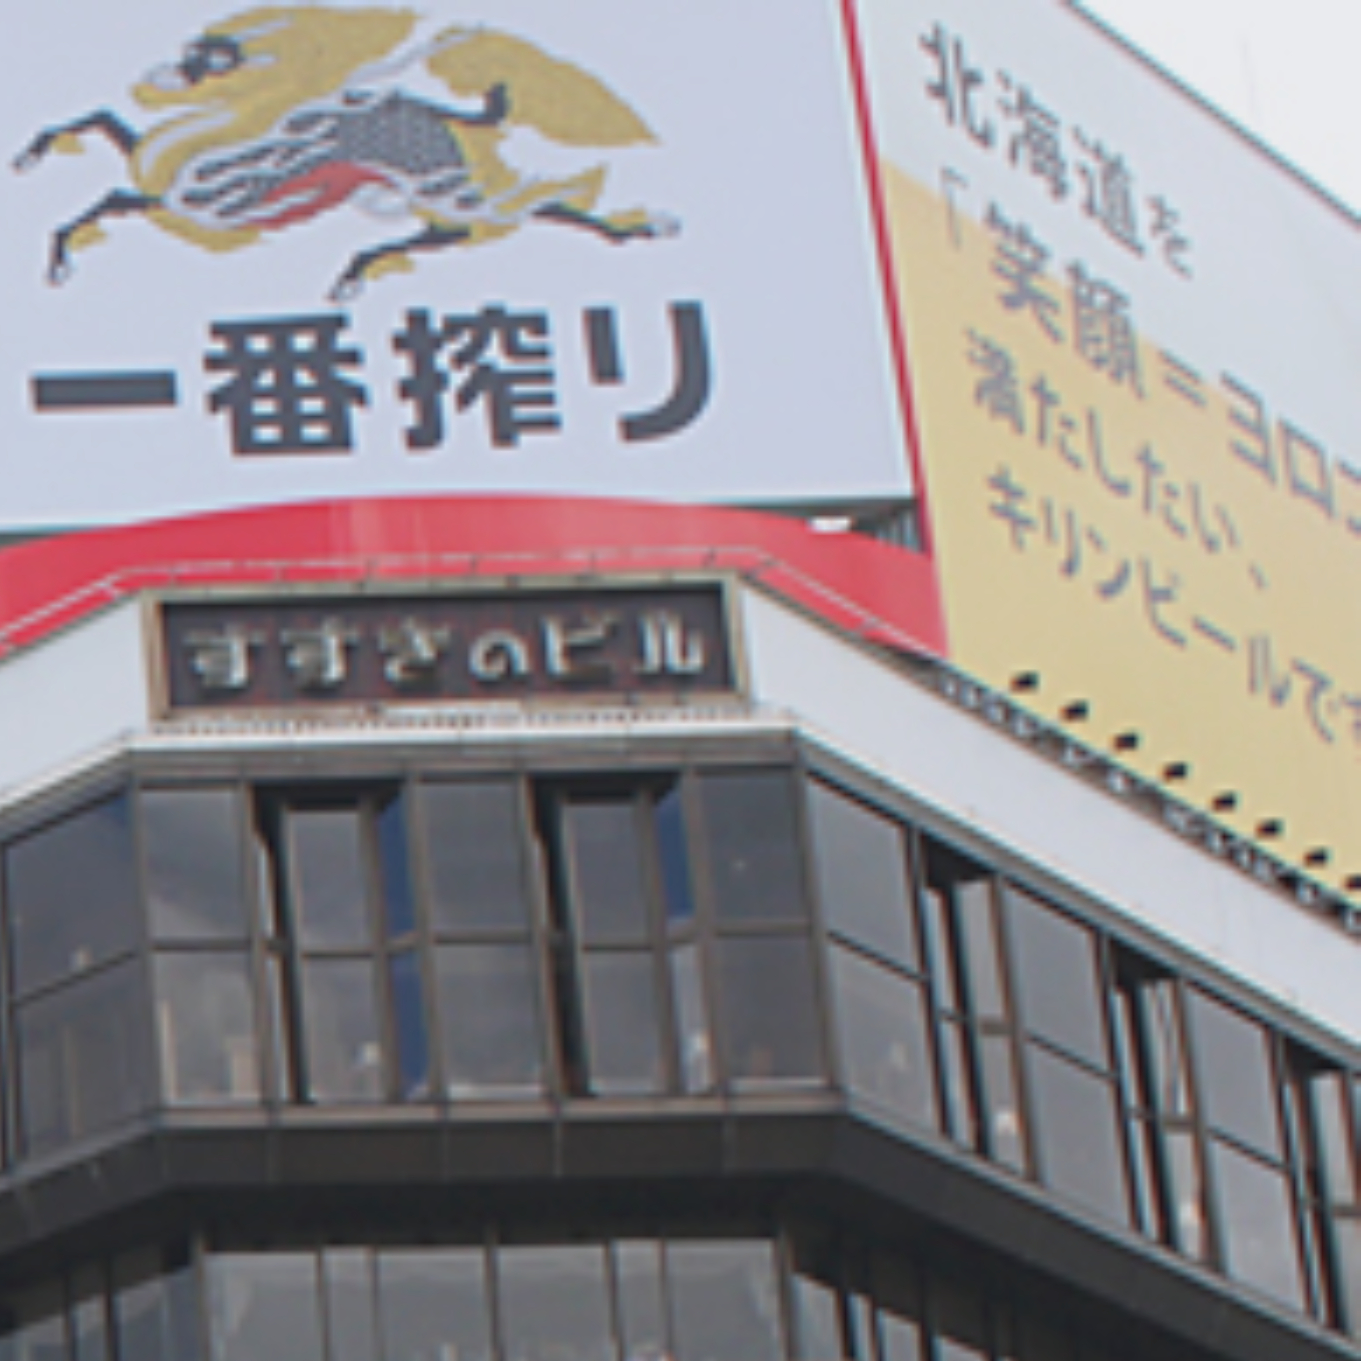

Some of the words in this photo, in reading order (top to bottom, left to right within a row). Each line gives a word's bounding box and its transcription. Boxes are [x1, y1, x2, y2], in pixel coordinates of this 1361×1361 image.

[919, 21, 1193, 279] 北海道を
[30, 300, 712, 457] 一番搾り
[182, 608, 707, 690] すすきのビル
